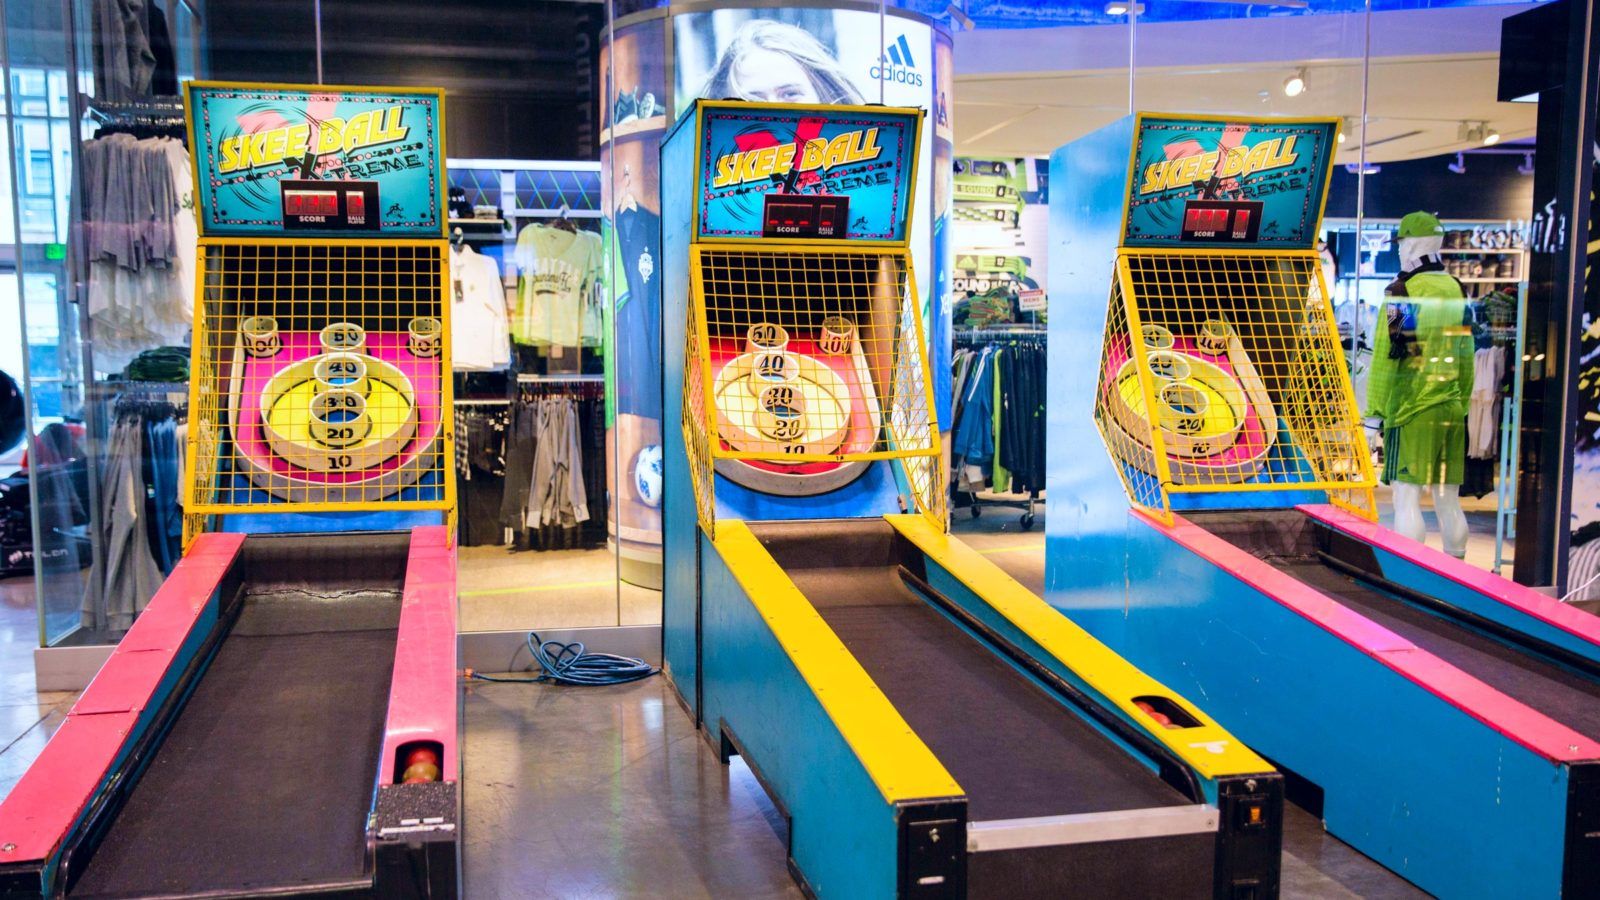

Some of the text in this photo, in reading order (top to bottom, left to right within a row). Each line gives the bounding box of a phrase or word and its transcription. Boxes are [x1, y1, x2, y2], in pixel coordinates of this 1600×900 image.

[869, 63, 923, 87] adidas
[219, 106, 410, 175] SKEE BALL
[713, 127, 883, 188] SKEE BALL
[1140, 135, 1299, 195] SKEE BALL
[299, 215, 326, 223] SCORE
[752, 325, 777, 343] 50
[247, 336, 278, 353] 100
[823, 335, 851, 353] 100
[329, 362, 357, 374] 40
[759, 355, 785, 373] 40
[767, 387, 793, 405] 30
[327, 428, 354, 439] 20
[773, 419, 800, 437] 20
[1177, 418, 1205, 431] 20
[1192, 443, 1210, 453] 10
[328, 456, 352, 469] 10
